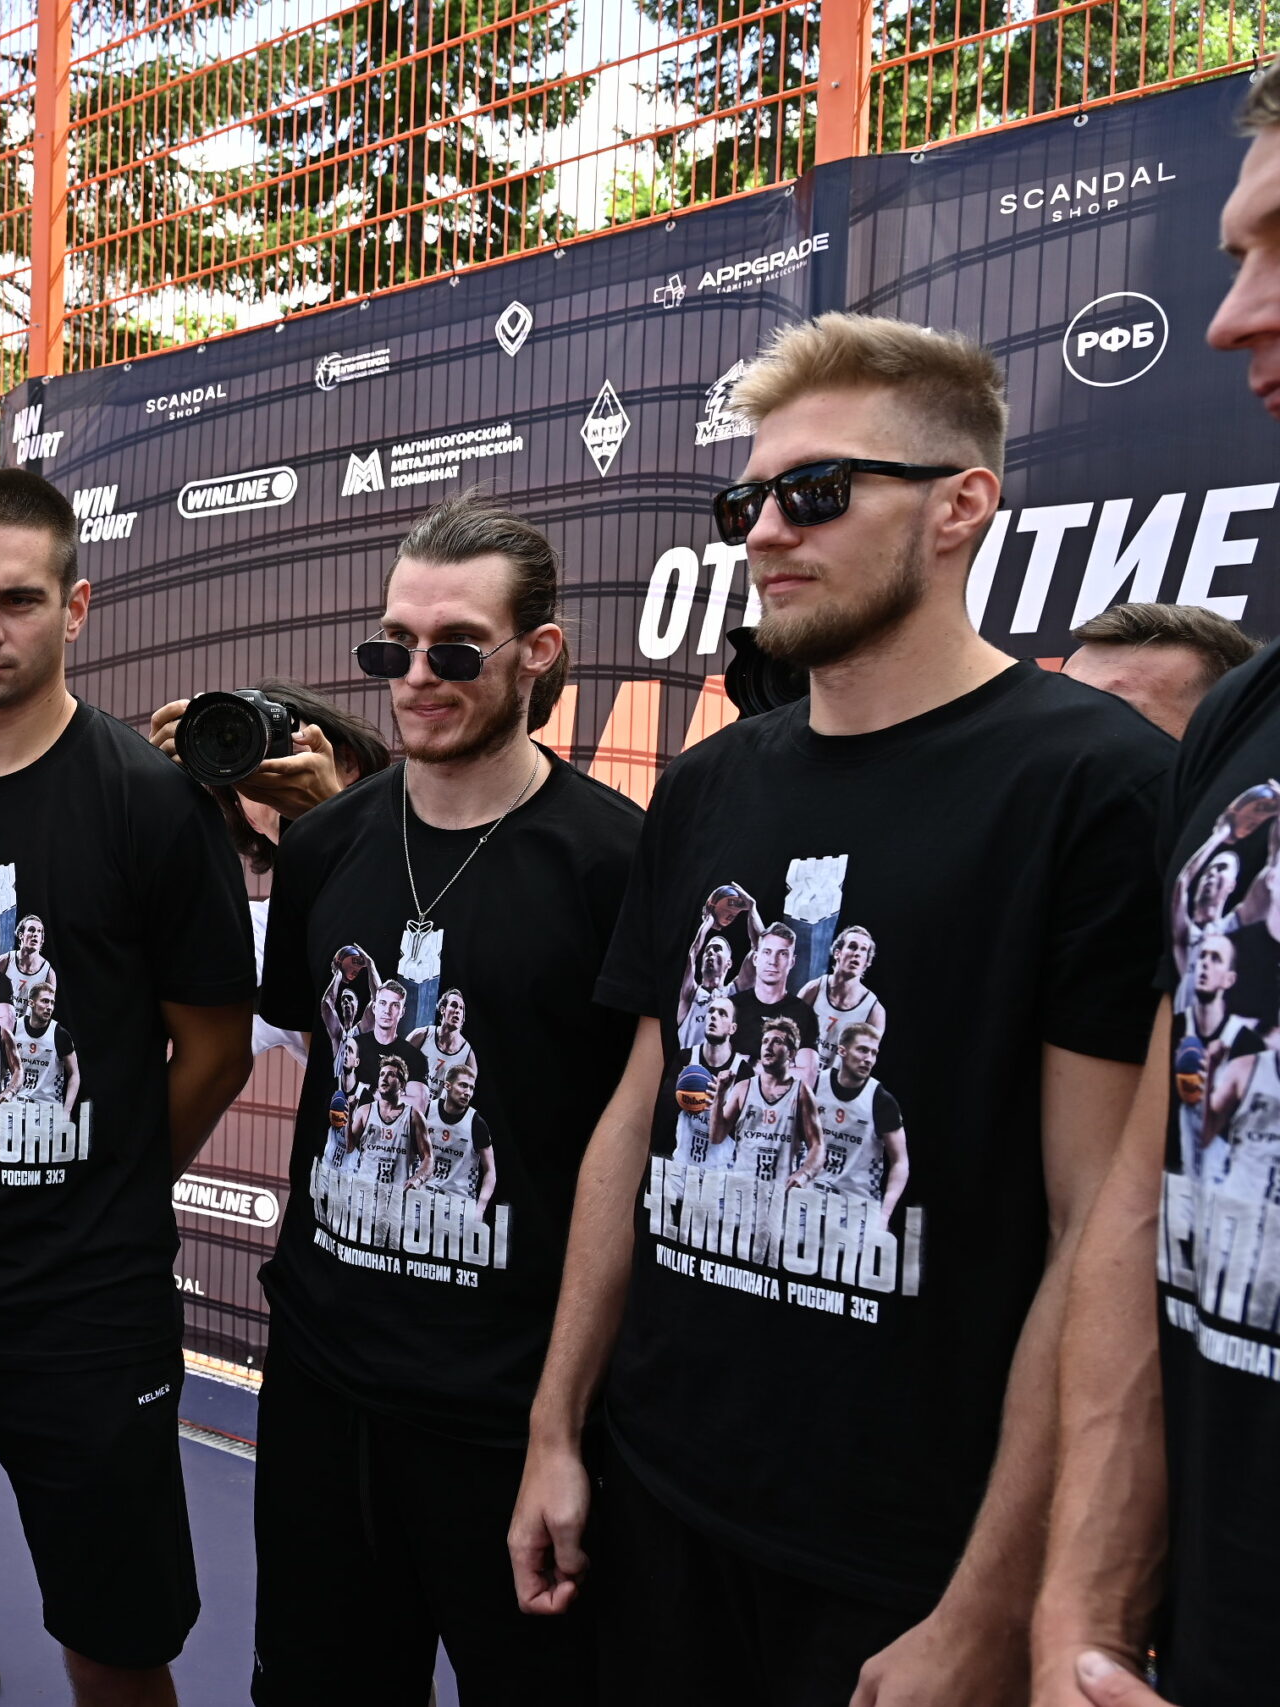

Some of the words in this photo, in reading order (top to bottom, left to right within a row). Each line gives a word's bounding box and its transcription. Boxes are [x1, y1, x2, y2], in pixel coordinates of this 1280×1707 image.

[1000, 162, 1176, 215] SCANDAL
[1052, 199, 1119, 223] SHOP
[697, 232, 830, 290] APPGRADE
[1077, 321, 1154, 357] РФБ
[145, 384, 227, 413] SCANDAL
[169, 406, 201, 420] SHOP
[390, 436, 523, 473] МЕТАЛЛУРГИЧЕСКИЙ
[391, 422, 512, 458] МАГНИТОГОРСКИЙ
[187, 477, 271, 511] WINLINE
[390, 465, 460, 489] КОМБИНАТ
[72, 484, 119, 520] WIN
[79, 511, 138, 543] COURT
[835, 1108, 845, 1124] 9
[366, 1144, 407, 1155] КУРЧАТОВ
[743, 1130, 792, 1143] КУРЧАТОВ
[1, 1169, 41, 1186] РОССИИ
[173, 1181, 253, 1215] WINLINE
[644, 1155, 923, 1297] ЧЕМПИОНЫ
[337, 1242, 401, 1275] ЧЕМПИОНАТА
[406, 1260, 451, 1283] РОССИИ
[656, 1243, 696, 1278] WINLINE
[700, 1258, 780, 1302] ЧЕМПИОНАТА
[787, 1281, 845, 1316] РОССИИ
[138, 1386, 166, 1406] KELME
